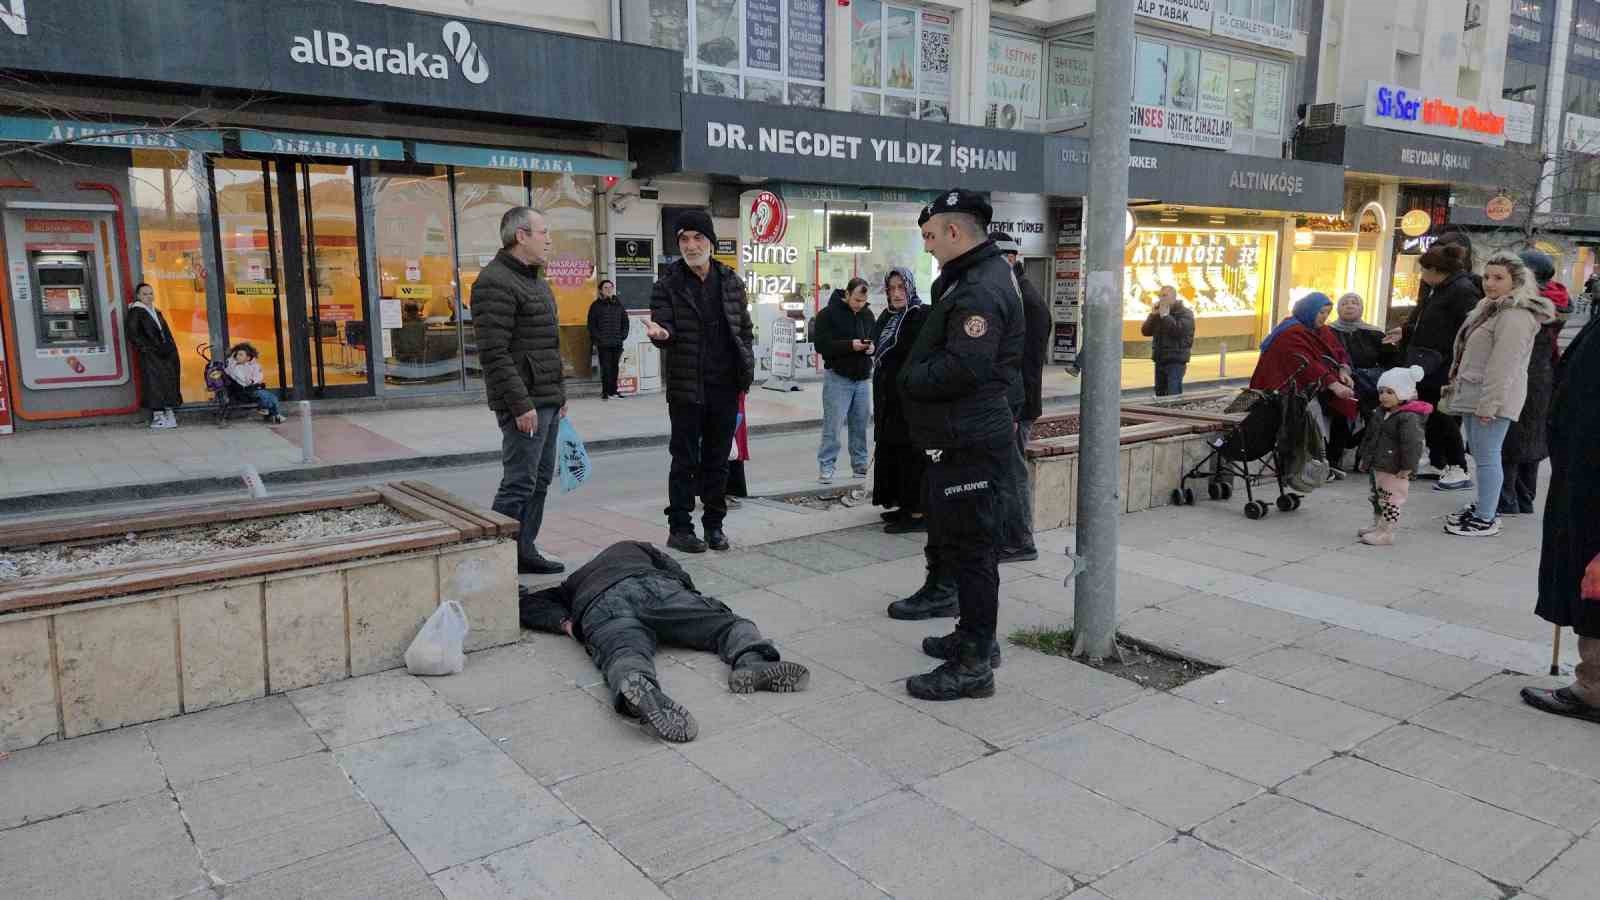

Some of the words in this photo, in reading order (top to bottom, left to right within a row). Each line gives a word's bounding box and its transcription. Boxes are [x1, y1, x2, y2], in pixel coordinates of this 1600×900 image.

[1137, 0, 1156, 14] ALP
[1159, 4, 1189, 23] TABAK
[290, 29, 449, 80] alBaraka
[272, 138, 380, 157] ALBARAKA
[706, 121, 754, 151] DR.
[758, 127, 862, 160] NECDET
[870, 138, 943, 167] YILDIZ
[950, 139, 1017, 173] İŞHANI
[487, 155, 573, 172] ALBARAKA
[1401, 149, 1441, 166] MEYDAN
[1017, 219, 1044, 234] TÜRKER
